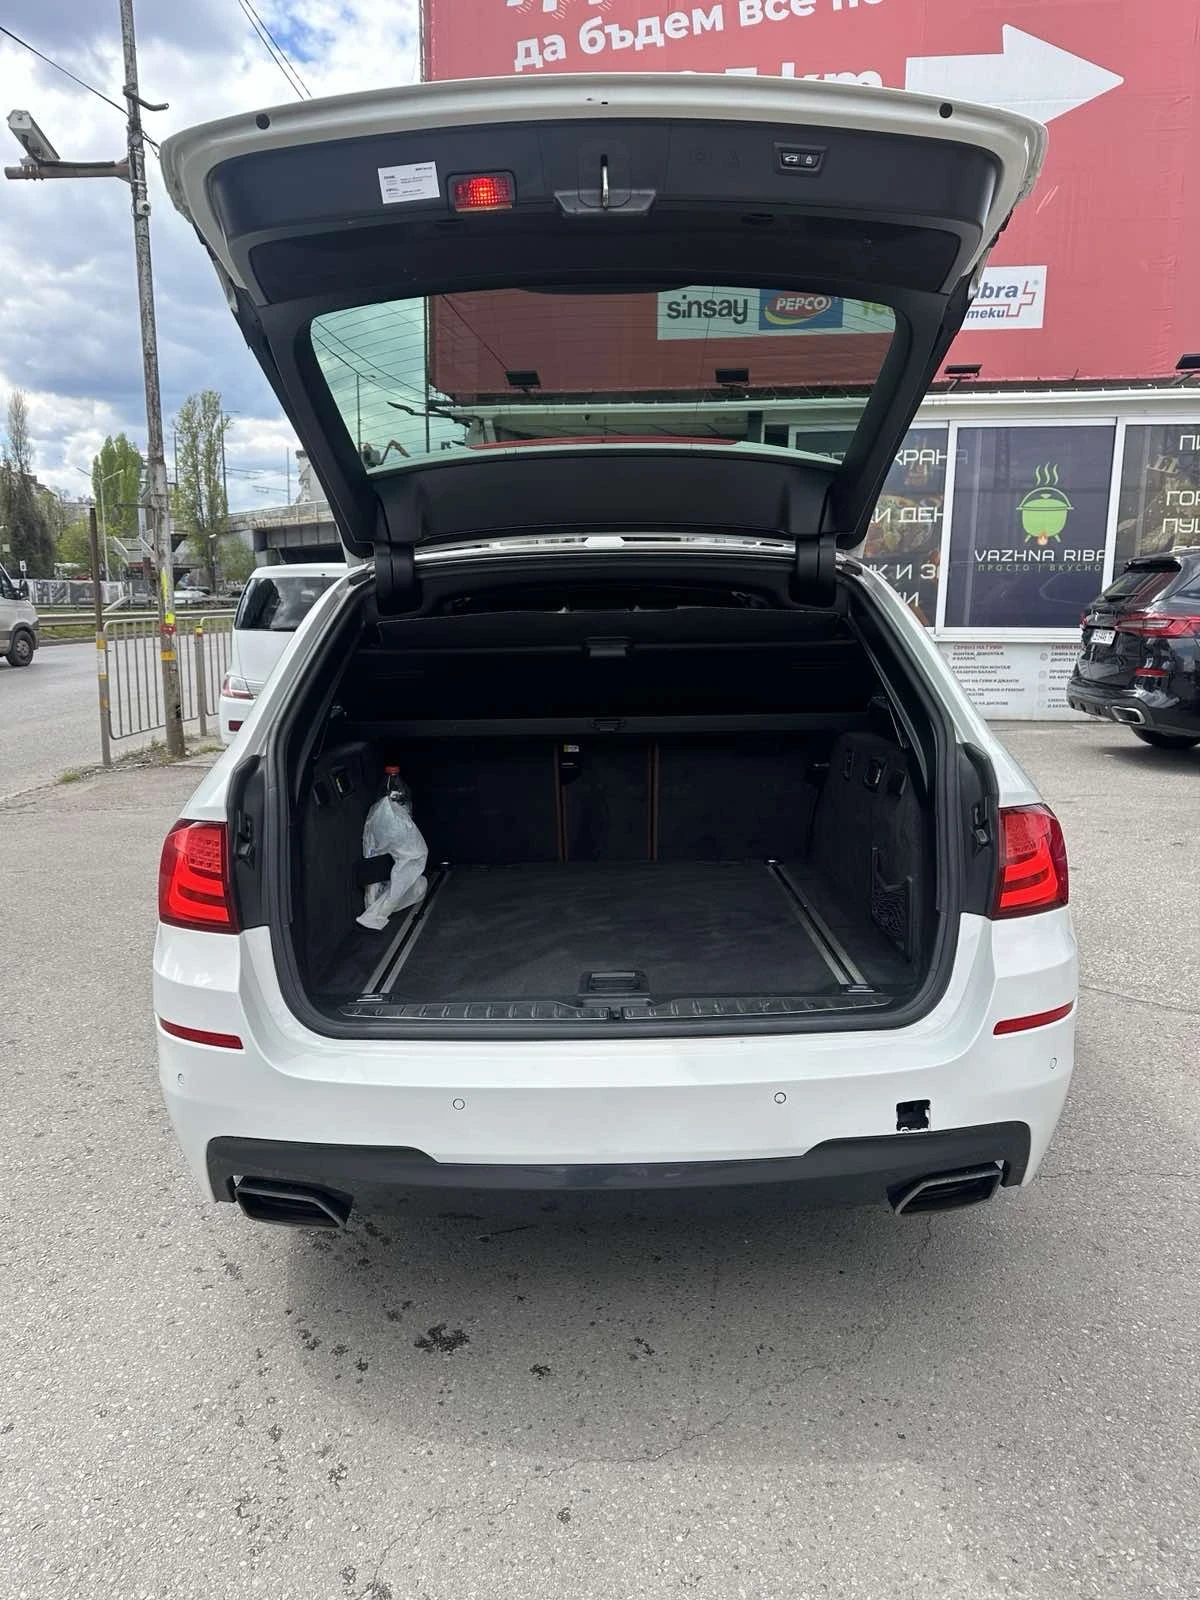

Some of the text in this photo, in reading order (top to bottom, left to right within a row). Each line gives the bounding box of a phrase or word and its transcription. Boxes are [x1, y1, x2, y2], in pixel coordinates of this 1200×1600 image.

[514, 34, 567, 72] да
[579, 5, 724, 54] бъдем
[667, 295, 827, 324] sinsay PEPCO
[974, 549, 1055, 562] VAZHNA
